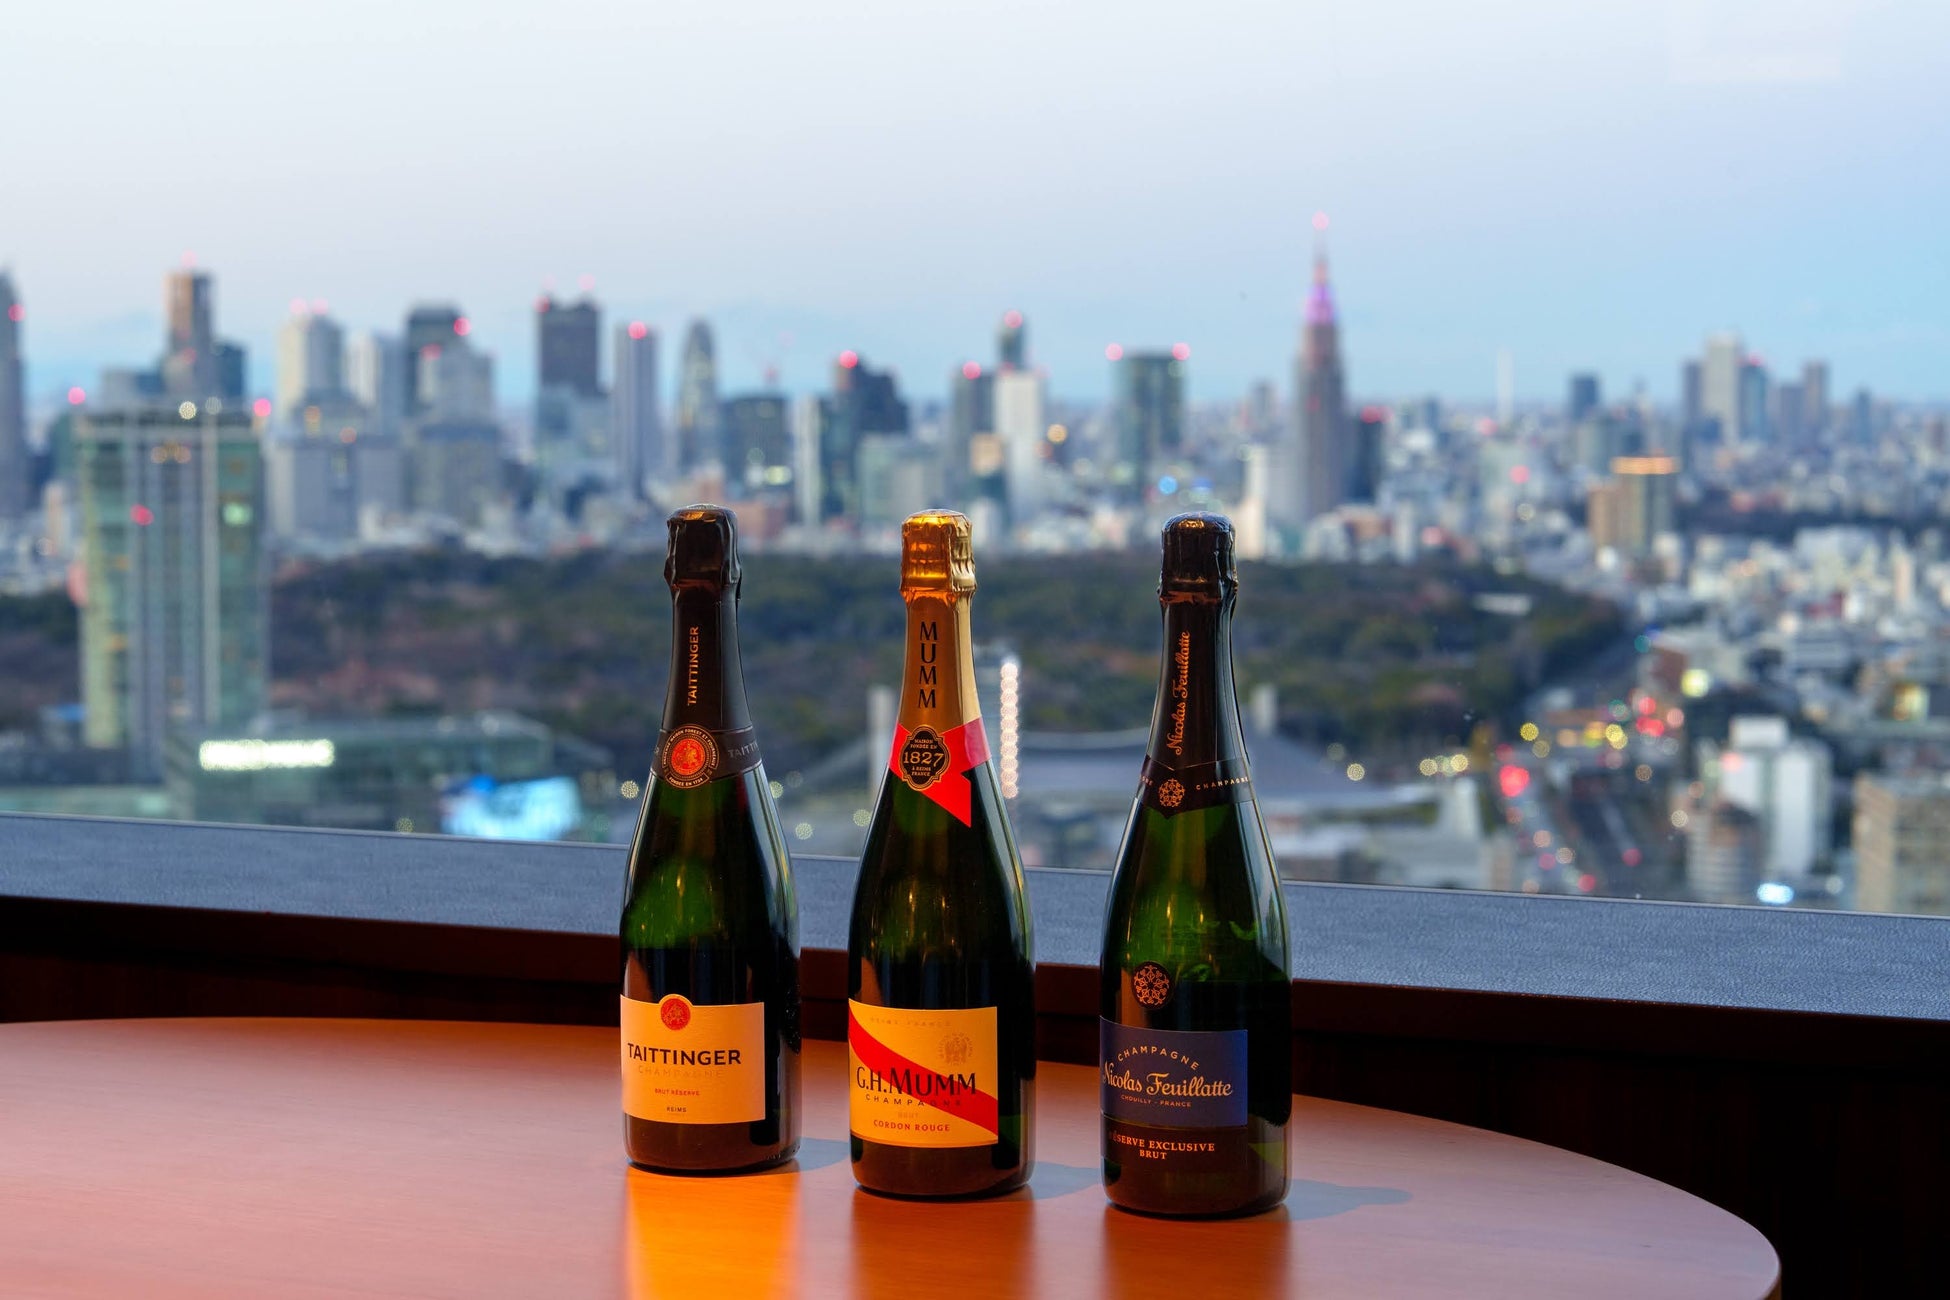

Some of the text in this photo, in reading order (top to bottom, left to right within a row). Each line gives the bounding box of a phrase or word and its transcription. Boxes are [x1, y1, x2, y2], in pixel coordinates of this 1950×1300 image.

[687, 626, 699, 707] TAITTINGER
[918, 621, 938, 709] MUMM
[1166, 629, 1190, 756] Nicolas Feuillatte
[903, 751, 944, 767] 1827
[627, 1042, 741, 1066] TAITTINGER
[1117, 1045, 1200, 1071] CHAMPAGNE
[1103, 1060, 1234, 1098] Nicolas Feuillatte
[654, 1087, 669, 1095] BRUT
[865, 1093, 962, 1107] CHAMPAGNE
[1120, 1094, 1152, 1105] CHOUILLY
[1159, 1100, 1192, 1108] FRANCE
[873, 1119, 950, 1132] CORDON ROUGE
[1149, 1140, 1216, 1152] EXCLUSIVE
[1139, 1149, 1168, 1160] BRUT
